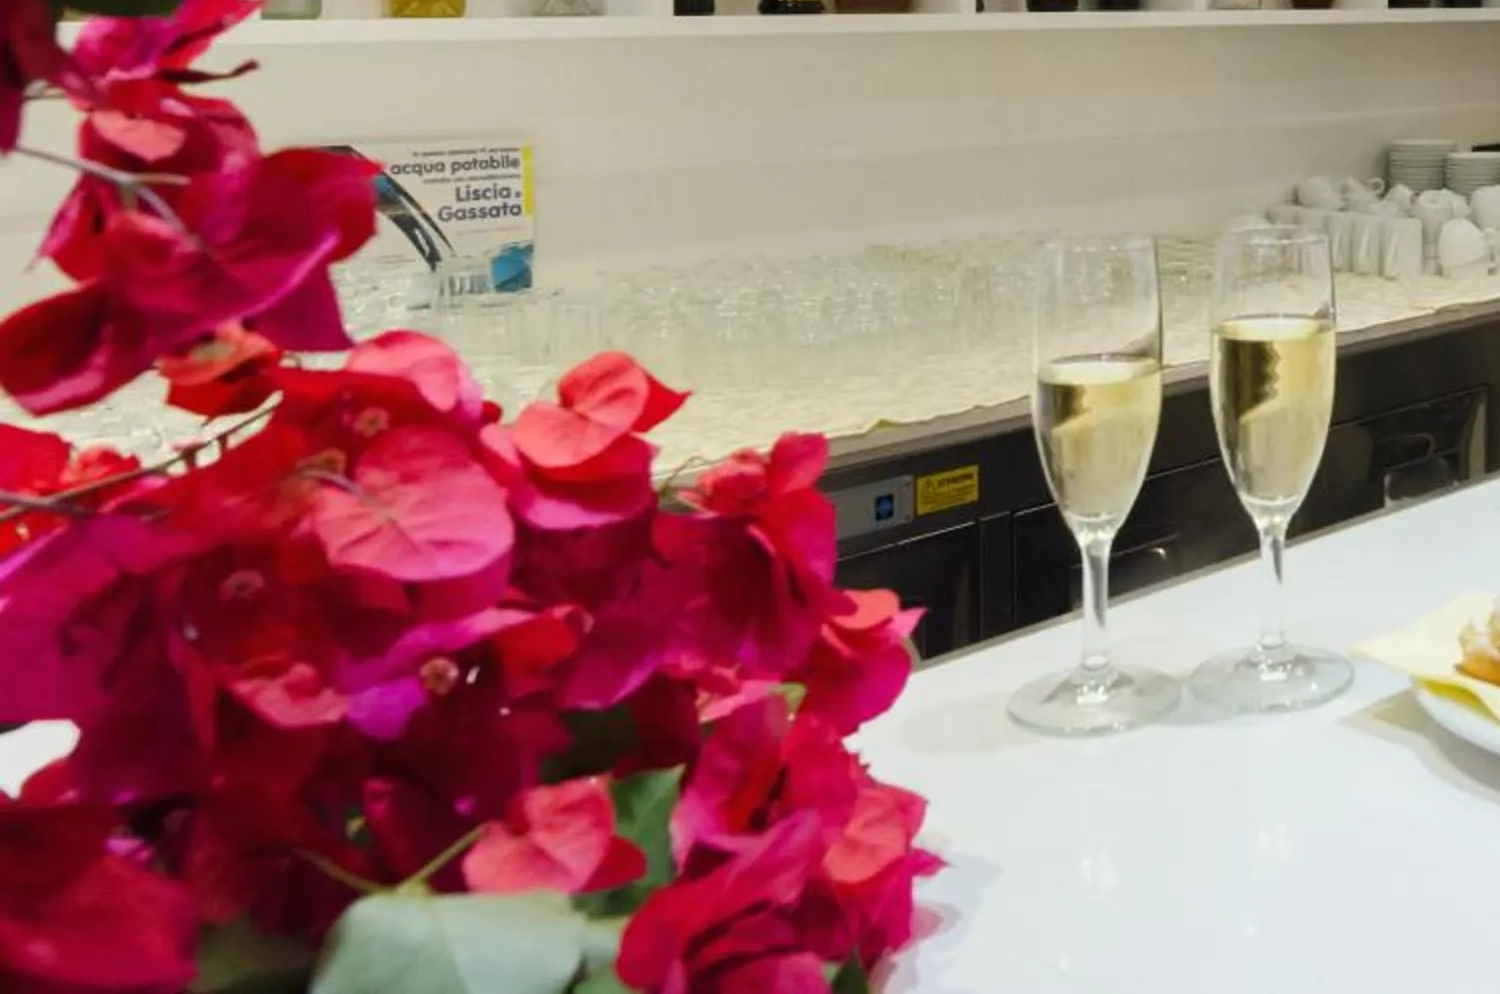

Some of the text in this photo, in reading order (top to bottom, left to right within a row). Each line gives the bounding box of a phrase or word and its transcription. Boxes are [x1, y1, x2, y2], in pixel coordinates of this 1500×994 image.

[390, 155, 521, 176] acqua potabile
[455, 183, 511, 202] Liscia
[438, 202, 522, 222] Gassata
